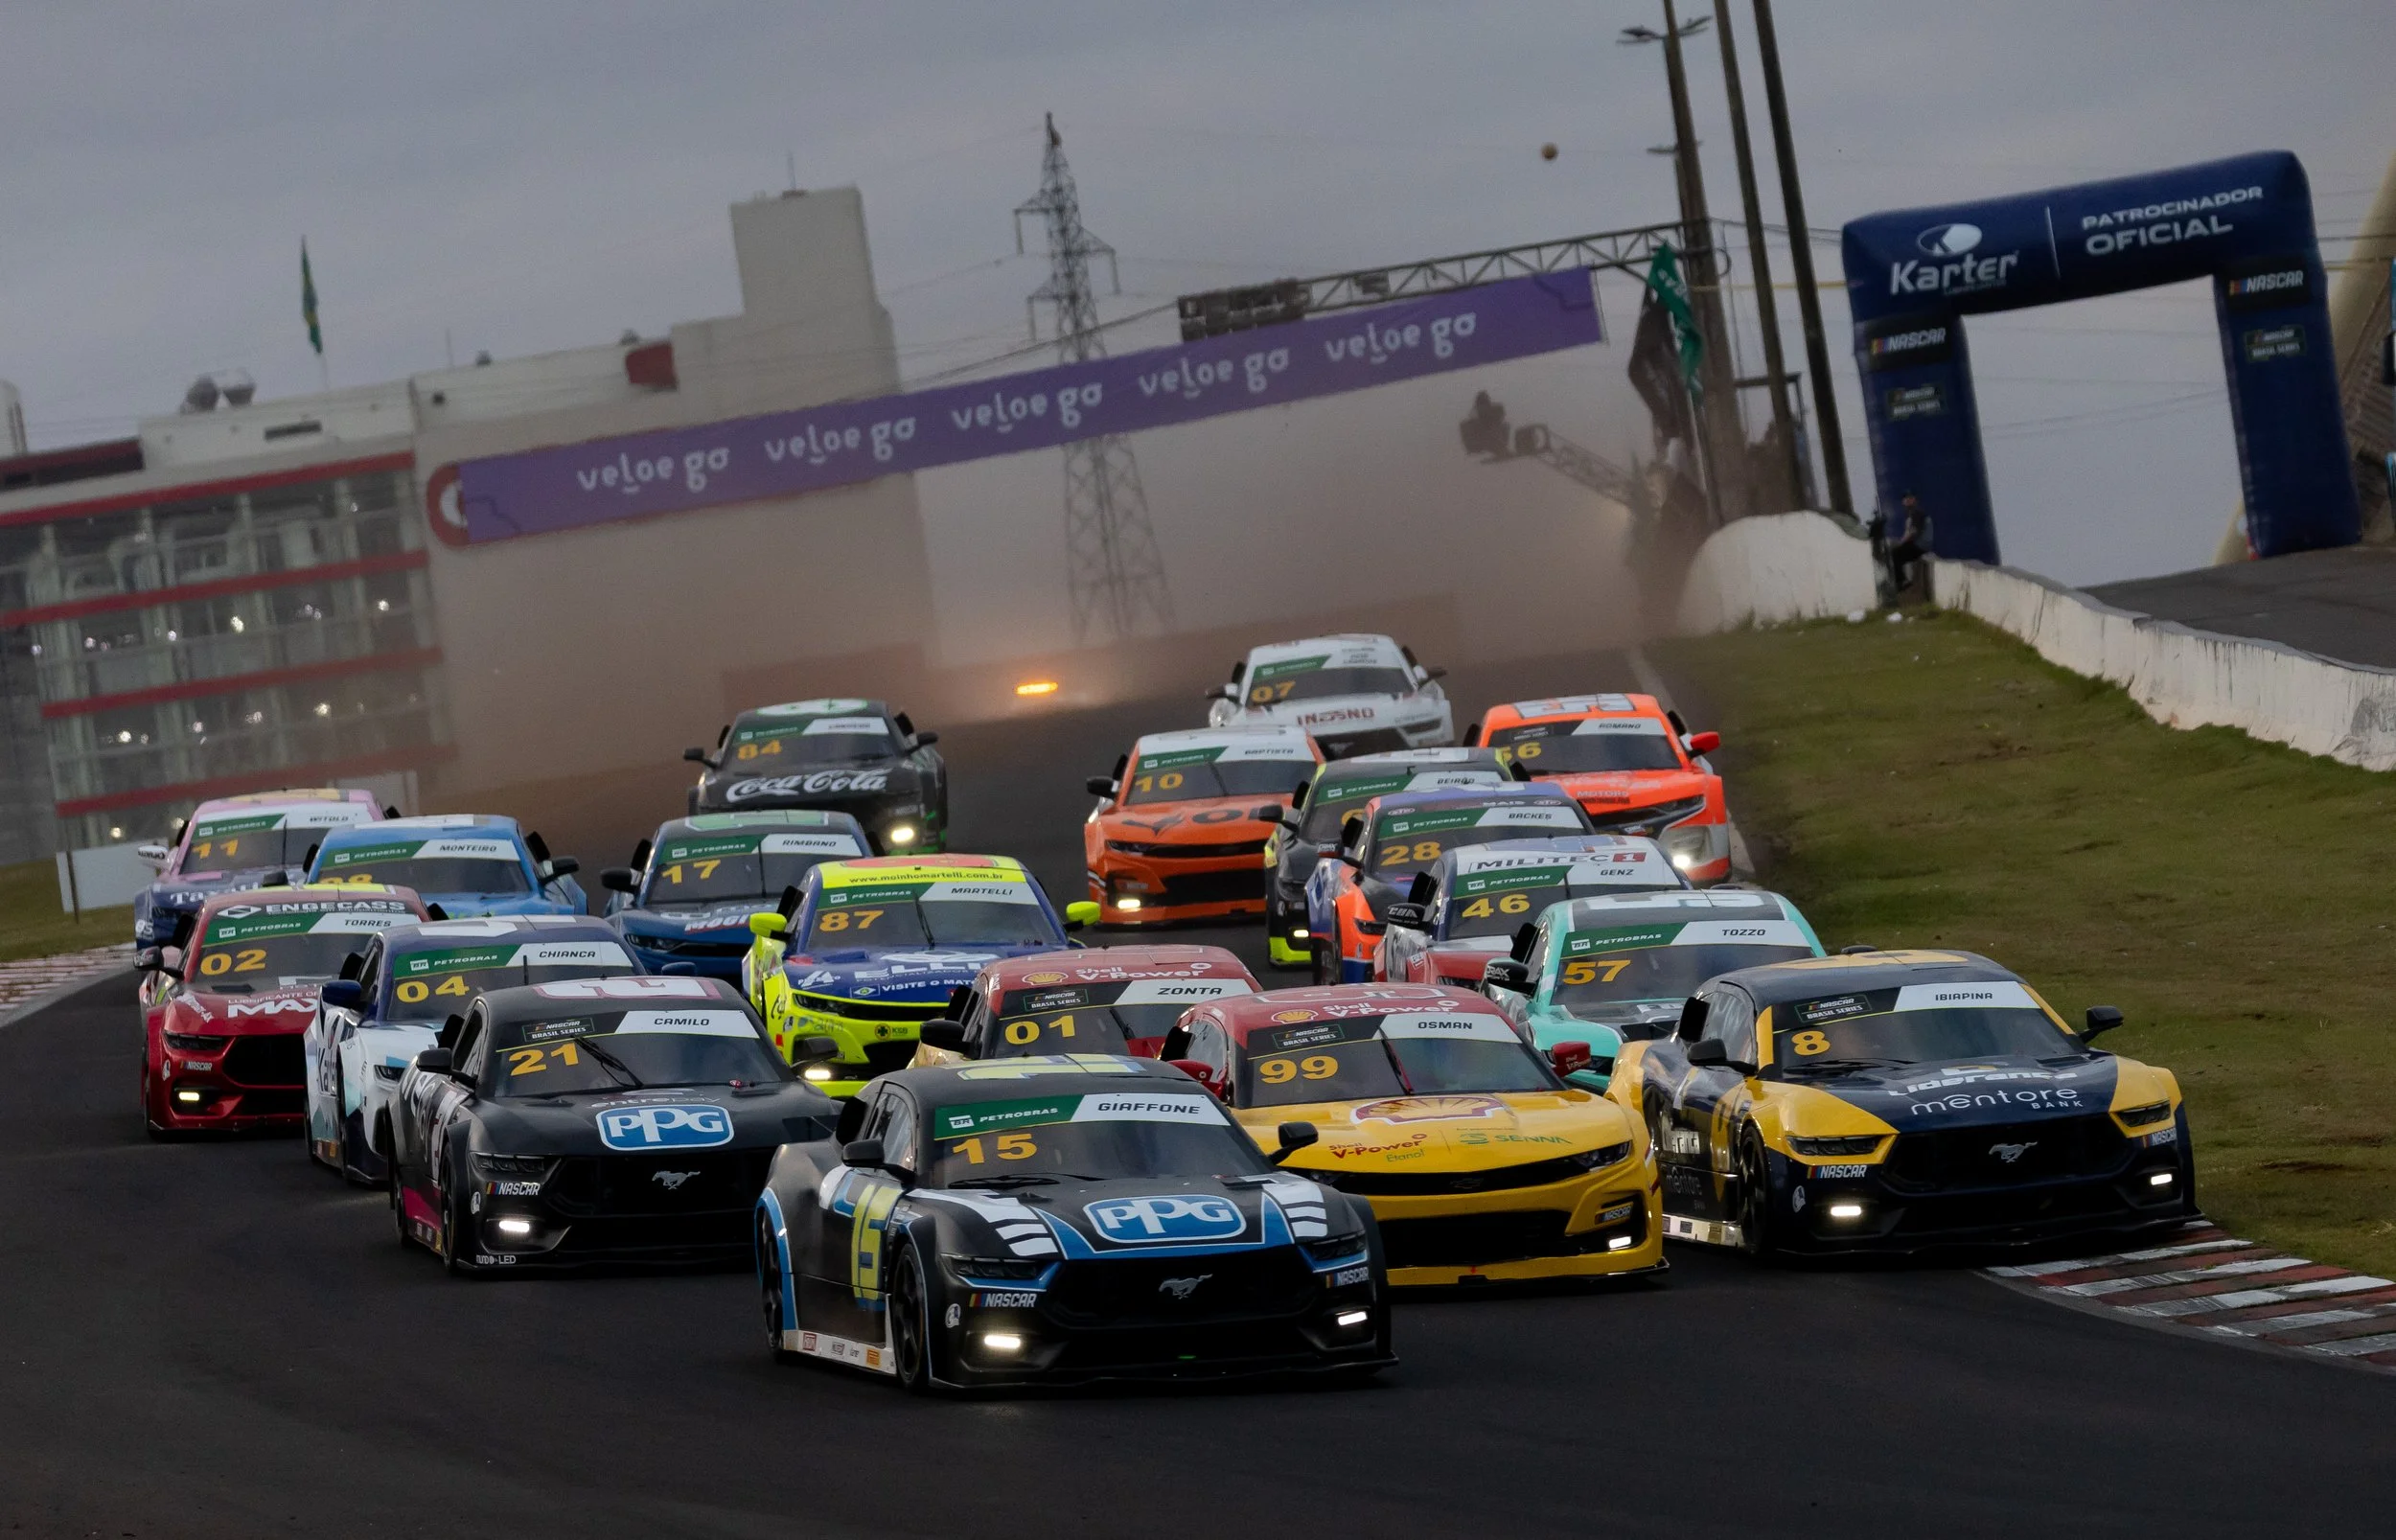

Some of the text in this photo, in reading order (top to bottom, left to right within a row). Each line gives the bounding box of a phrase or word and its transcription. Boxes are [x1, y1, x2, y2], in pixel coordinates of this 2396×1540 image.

[2082, 185, 2264, 231] PATROCINADOR
[2085, 215, 2233, 256] OFICIAL
[1890, 250, 2018, 295] Karter
[2246, 270, 2304, 293] NASCAR
[1325, 321, 1420, 364] veloe
[1888, 327, 1946, 353] NASCAR
[1139, 356, 1233, 399] veloe
[951, 393, 1048, 433] veloe
[765, 425, 861, 465] veloe
[578, 452, 673, 494] veloe
[1251, 680, 1296, 703] 07
[1135, 773, 1184, 792] 10
[1413, 816, 1468, 828] PETROBRAS
[192, 839, 239, 860] 11
[692, 843, 747, 855] PETROBRAS
[1381, 841, 1441, 865] 28
[1477, 853, 1608, 871] MILITEC
[661, 860, 721, 885] 17
[1489, 874, 1551, 885] PETROBRAS
[852, 890, 912, 901] PETROBRAS
[1462, 894, 1531, 918] 46
[241, 923, 302, 933] PETROBRAS
[819, 910, 885, 931] 87
[1596, 933, 1662, 945] PETROBRAS
[199, 949, 267, 976] 02
[433, 954, 497, 966] PETROBRAS
[539, 950, 596, 958] CHIANCA
[1075, 966, 1122, 975] Shell
[1078, 969, 1204, 980] V-Power
[1563, 960, 1631, 985] 57
[396, 976, 470, 1002] 04
[882, 980, 926, 992] VISITE
[1031, 998, 1081, 1009] BRASIL SERIES
[1044, 991, 1076, 1000] NASCAR
[1820, 998, 1855, 1009] NASCAR
[1935, 991, 1993, 1001] IBIAPINA
[1323, 1002, 1371, 1012] Shell
[1327, 1005, 1454, 1018] V-Power
[1807, 1005, 1863, 1020] BRASIL SERIES
[545, 1020, 581, 1030] NASCAR
[654, 1018, 710, 1026] CAMILO
[1005, 1015, 1075, 1046] 01
[1417, 1022, 1473, 1030] OSMAN
[531, 1026, 587, 1040] BRASIL SERIES
[1283, 1033, 1336, 1046] BRASIL SERIES
[1790, 1030, 1832, 1056] 8
[509, 1043, 580, 1076] 21
[1259, 1056, 1339, 1084] 99
[1098, 1102, 1200, 1115] GIAFFONE
[2031, 1100, 2084, 1110] BANK
[979, 1107, 1058, 1122] PETROBRAS
[607, 1108, 725, 1142] PPG
[953, 1133, 1038, 1165] 15
[1332, 1139, 1422, 1160] V-Power
[1386, 1149, 1426, 1162] Etanol
[1820, 1164, 1868, 1179] NASCAR
[498, 1183, 541, 1196] NASCAR
[1094, 1194, 1233, 1239] PPG
[1337, 1266, 1370, 1287] NASCAR
[984, 1292, 1038, 1308] NASCAR
